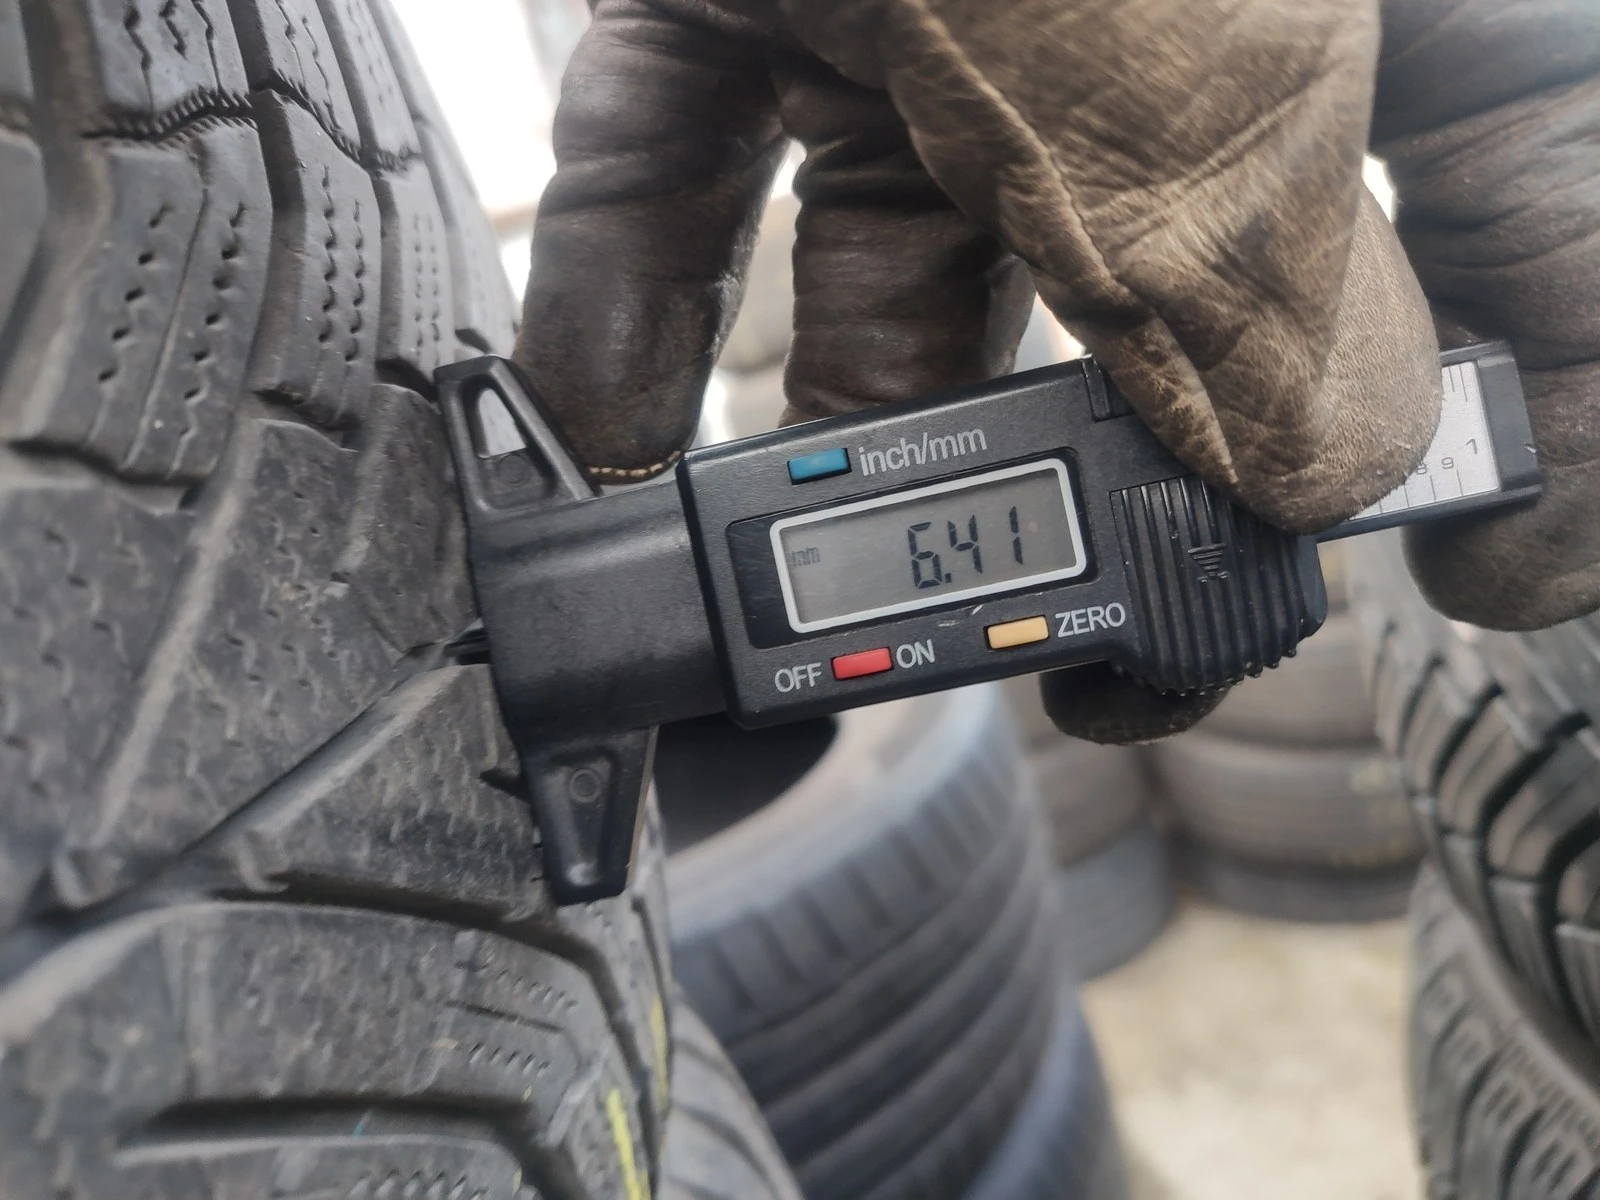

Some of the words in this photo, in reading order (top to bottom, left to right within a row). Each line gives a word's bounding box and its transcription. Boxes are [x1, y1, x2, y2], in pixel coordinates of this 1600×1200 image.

[859, 427, 987, 476] inch/mm
[1465, 438, 1478, 455] 1
[1441, 457, 1455, 470] 9
[906, 505, 1024, 589] 6.41
[1055, 603, 1126, 638] ZERO
[896, 640, 936, 669] ON
[774, 663, 822, 693] OFF
